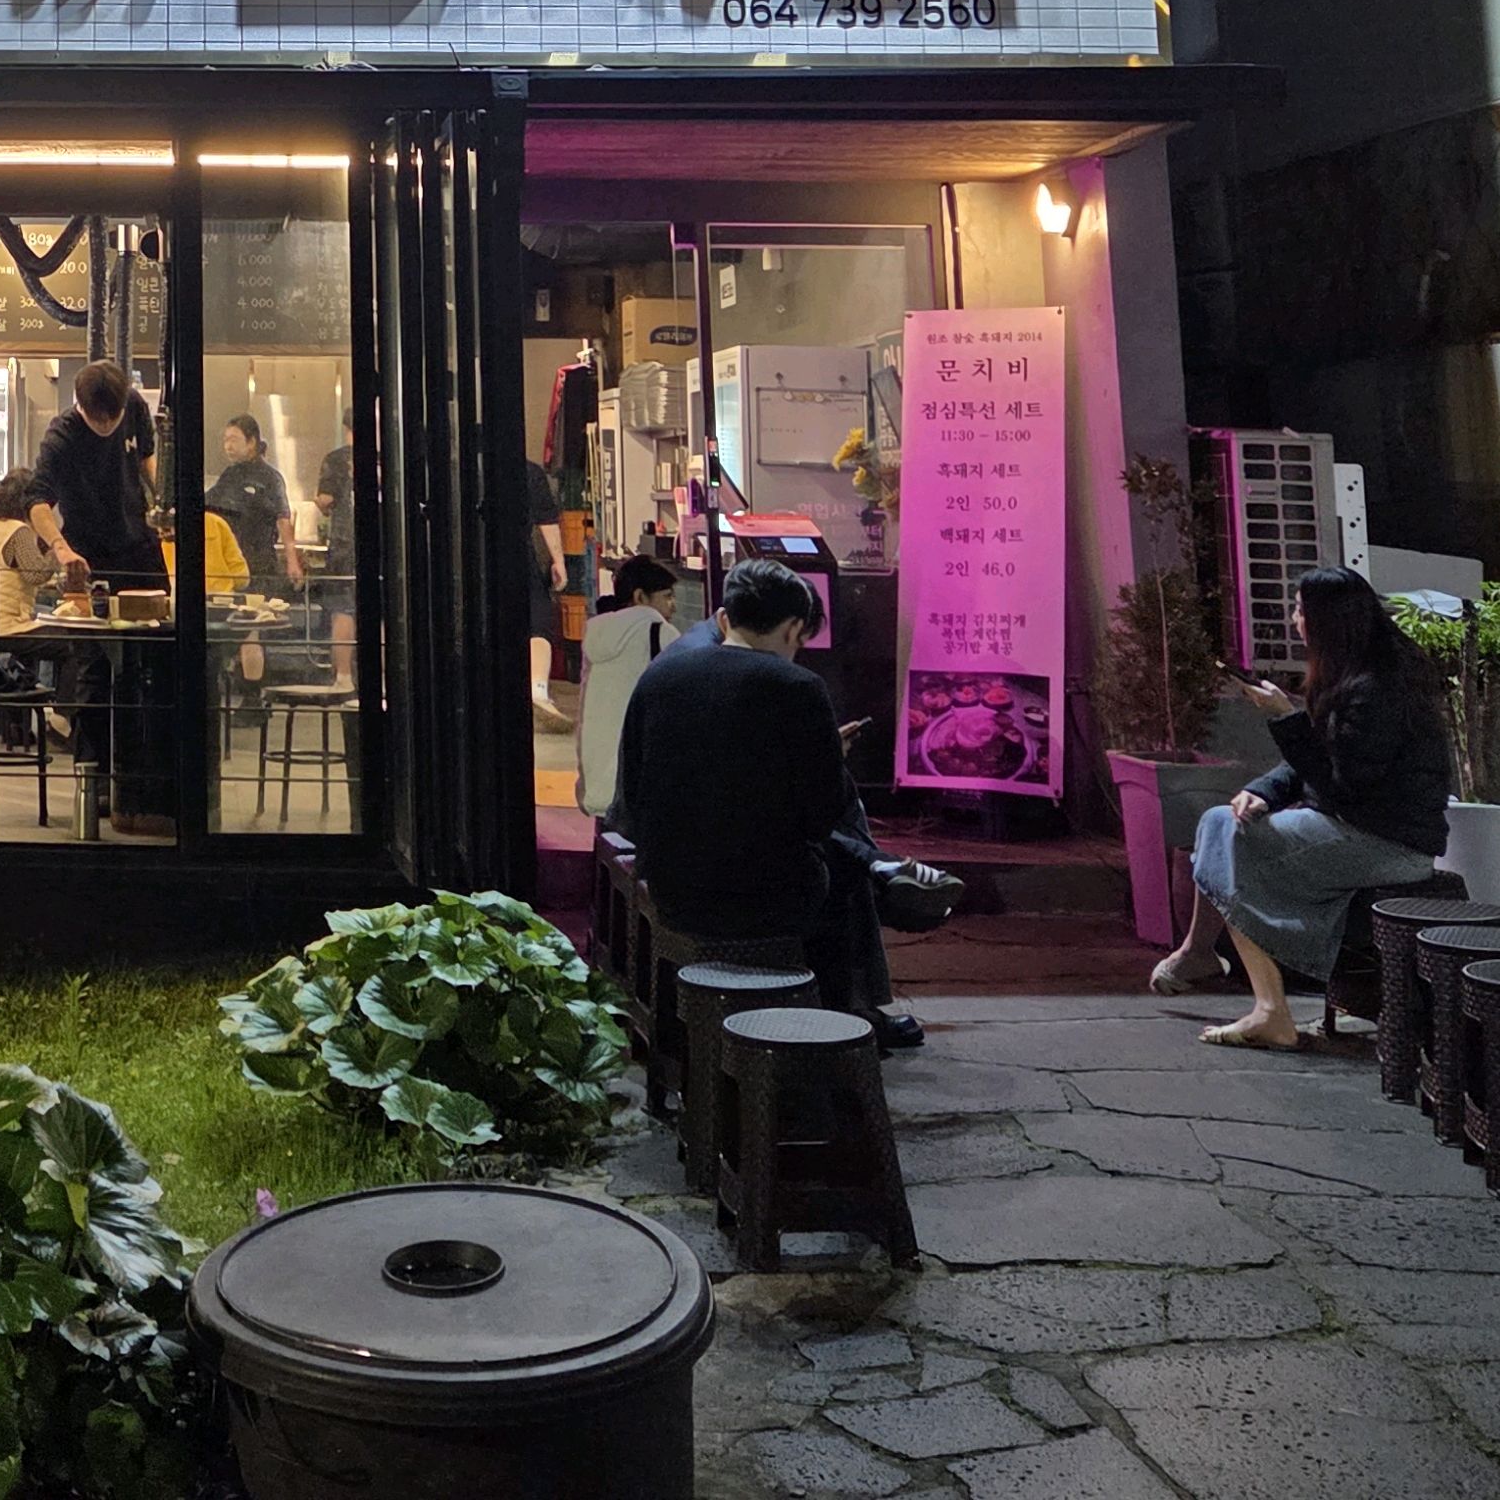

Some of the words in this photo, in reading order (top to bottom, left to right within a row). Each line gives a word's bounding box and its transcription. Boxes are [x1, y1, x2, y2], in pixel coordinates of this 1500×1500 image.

[979, 331, 1013, 343] 흑돼지
[1017, 331, 1043, 343] 2014
[920, 401, 996, 420] 점심특선
[1005, 400, 1044, 420] 세트
[940, 429, 975, 442] 11:30
[995, 429, 1031, 442] 15:00
[936, 462, 984, 479] 흑돼지
[991, 462, 1022, 479] 세트
[945, 494, 970, 512] 2인
[983, 495, 1018, 511] 50.0
[940, 527, 985, 544] 백돼지
[992, 527, 1024, 544] 세트
[944, 560, 969, 577] 2인
[981, 561, 1016, 577] 46.0
[927, 612, 967, 628] 흑돼지
